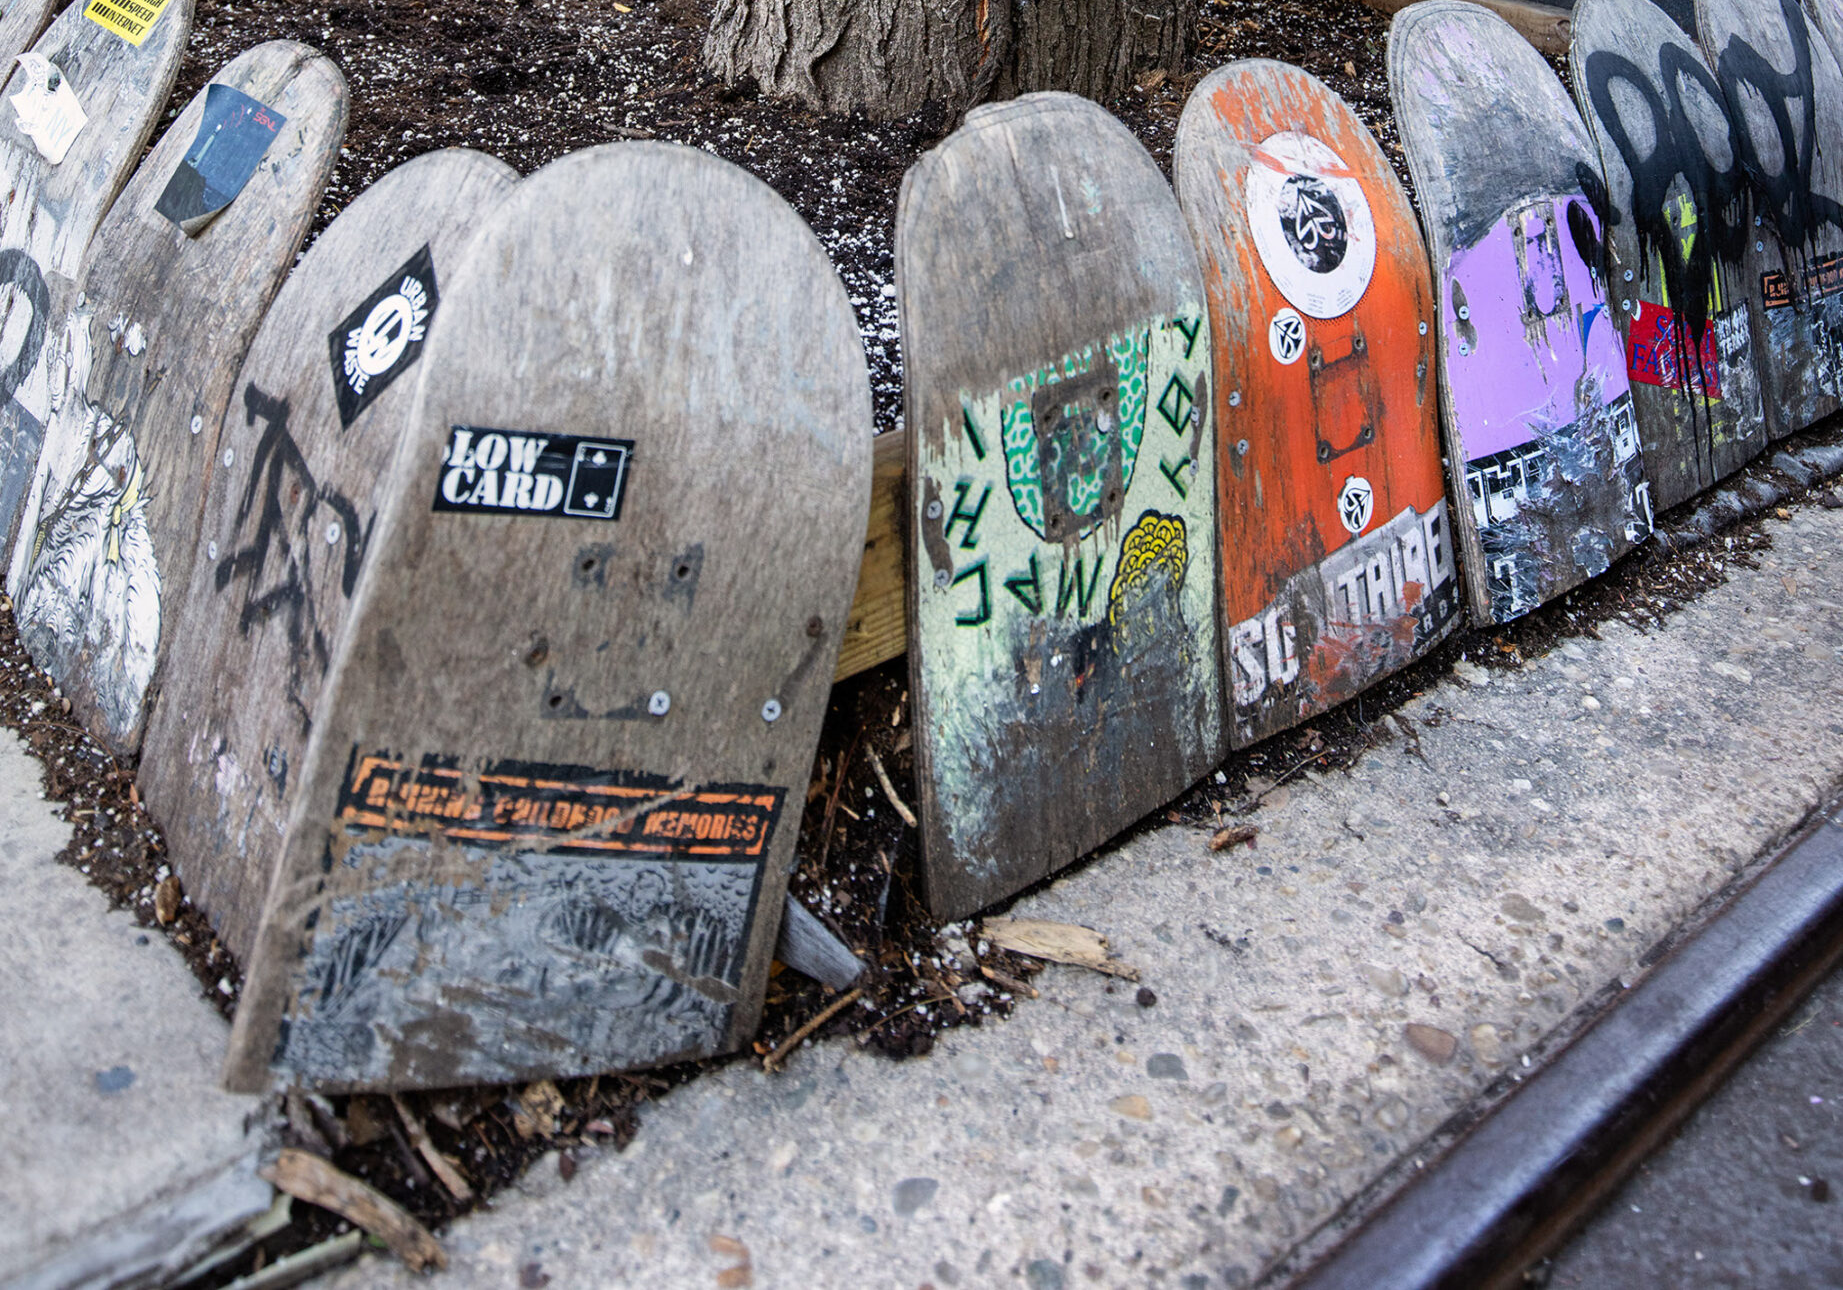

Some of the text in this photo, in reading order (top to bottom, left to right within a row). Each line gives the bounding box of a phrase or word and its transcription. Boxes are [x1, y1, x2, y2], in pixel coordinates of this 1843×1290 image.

[105, 9, 146, 37] INTERNET
[125, 1, 155, 23] SPEED
[399, 275, 429, 342] URBAN
[344, 326, 370, 396] WASTE
[447, 429, 549, 474] LOW
[441, 467, 565, 511] CARD
[1228, 507, 1450, 707] SOITAIRE
